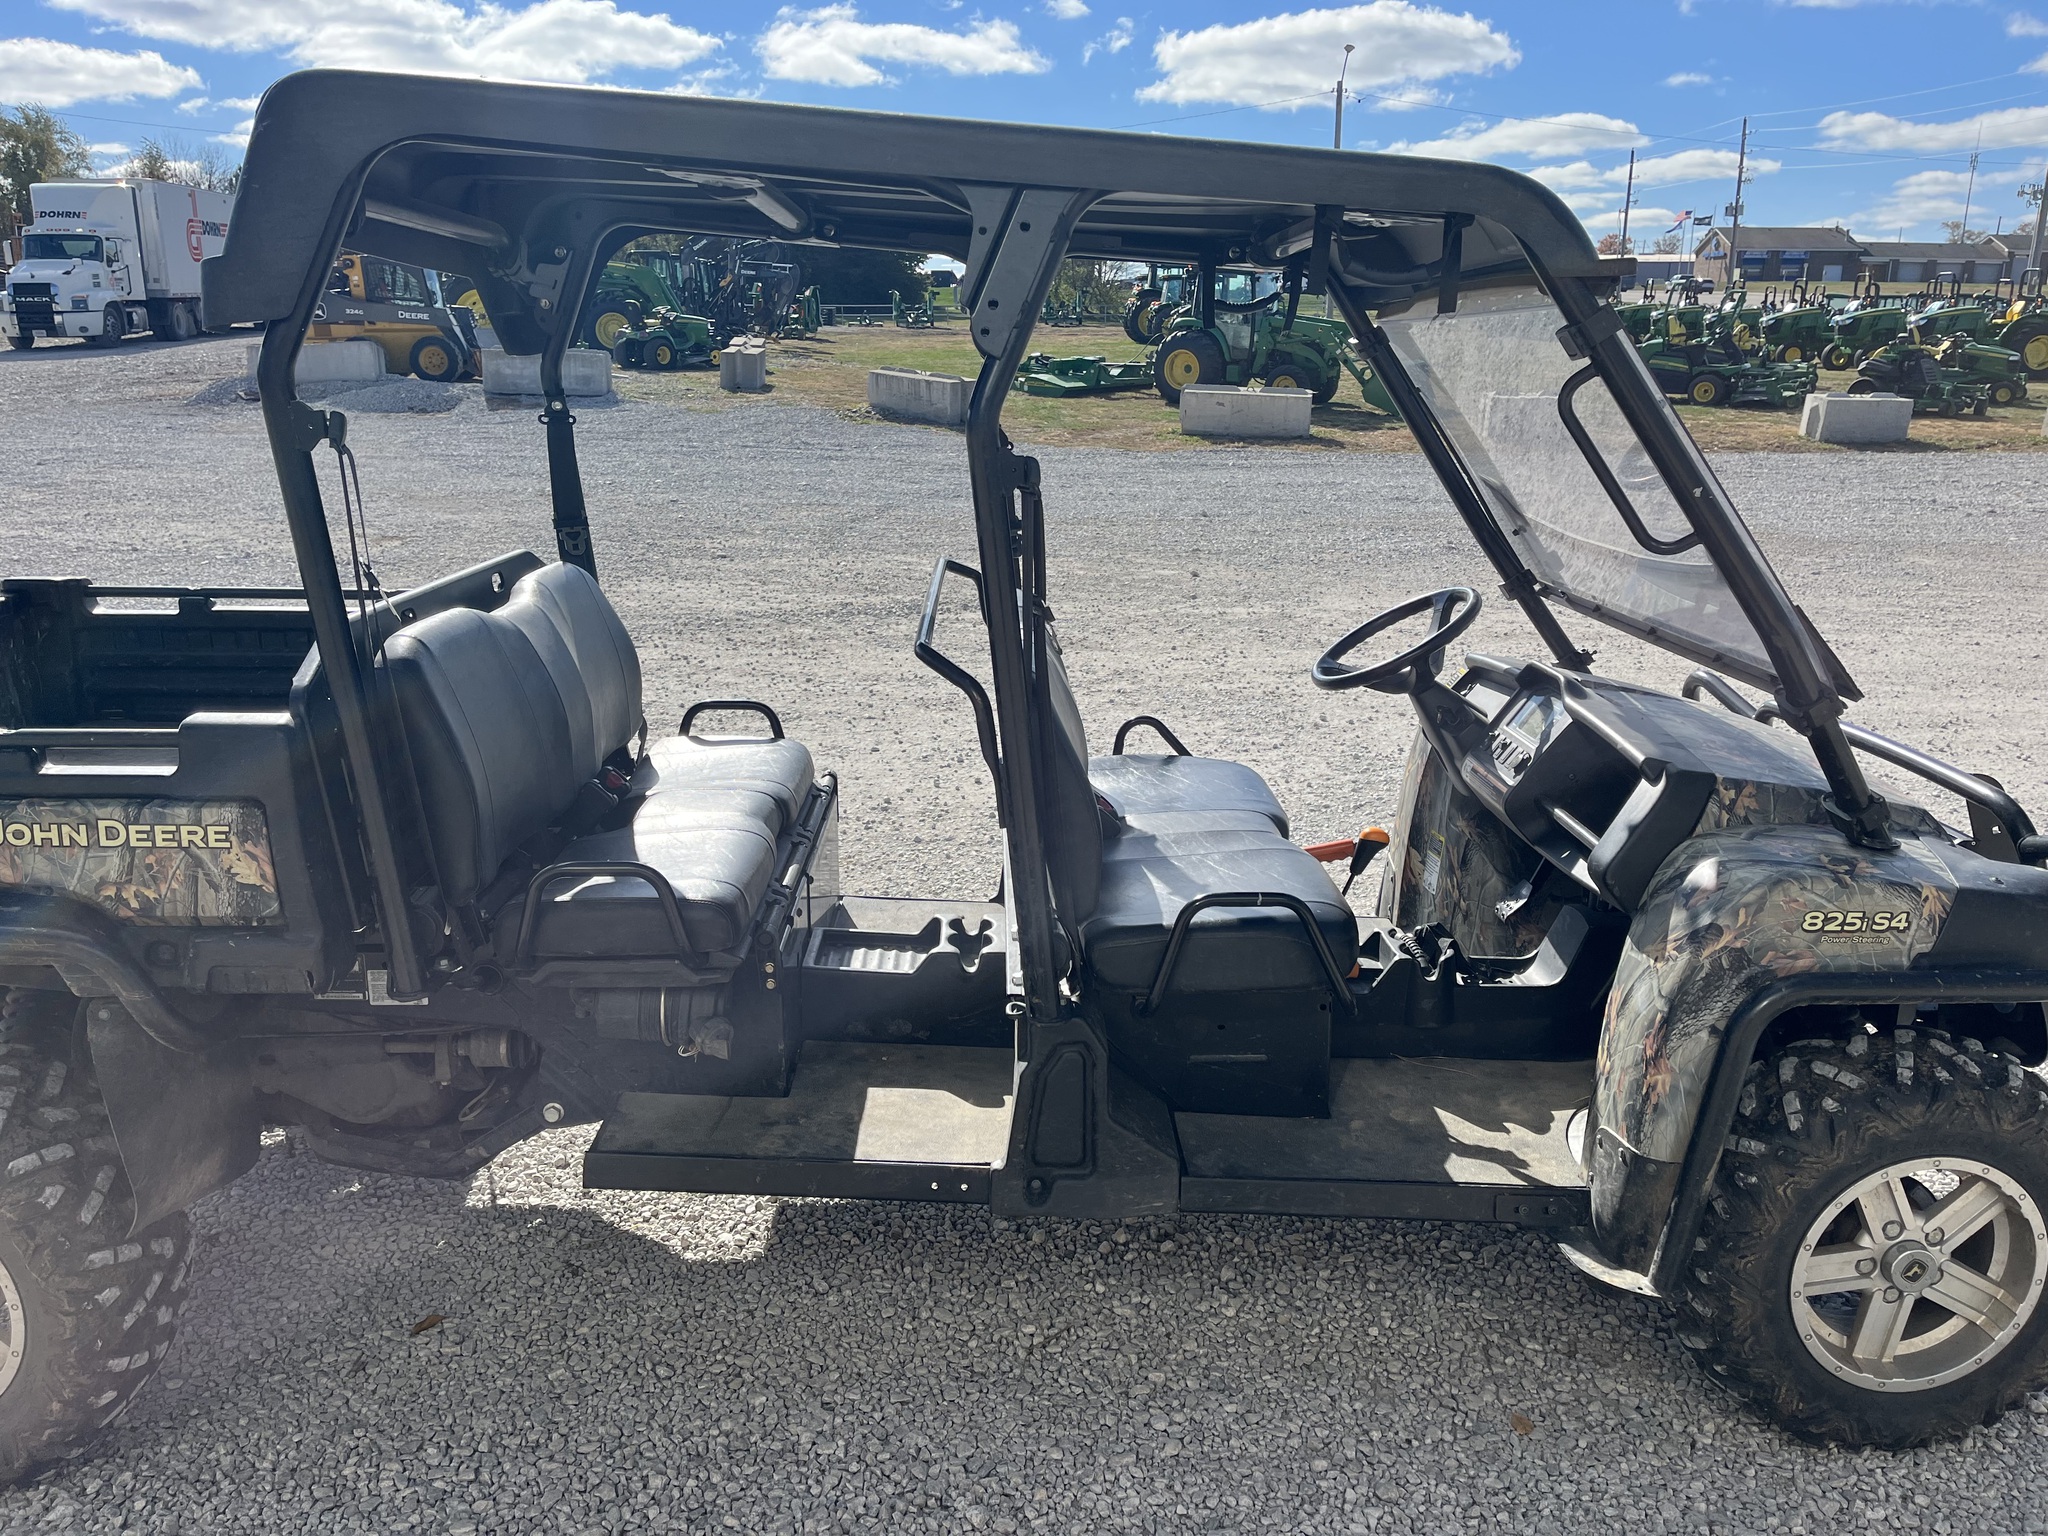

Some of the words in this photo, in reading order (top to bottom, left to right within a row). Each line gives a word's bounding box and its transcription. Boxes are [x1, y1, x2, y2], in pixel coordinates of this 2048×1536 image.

[40, 210, 81, 219] DOHRN
[398, 310, 430, 320] DEERE
[0, 817, 89, 847] OHN
[97, 818, 232, 849] DEERE
[1802, 911, 1868, 932] 825i
[1872, 911, 1909, 932] S4
[1820, 935, 1850, 944] Power
[1851, 935, 1890, 945] Steering
